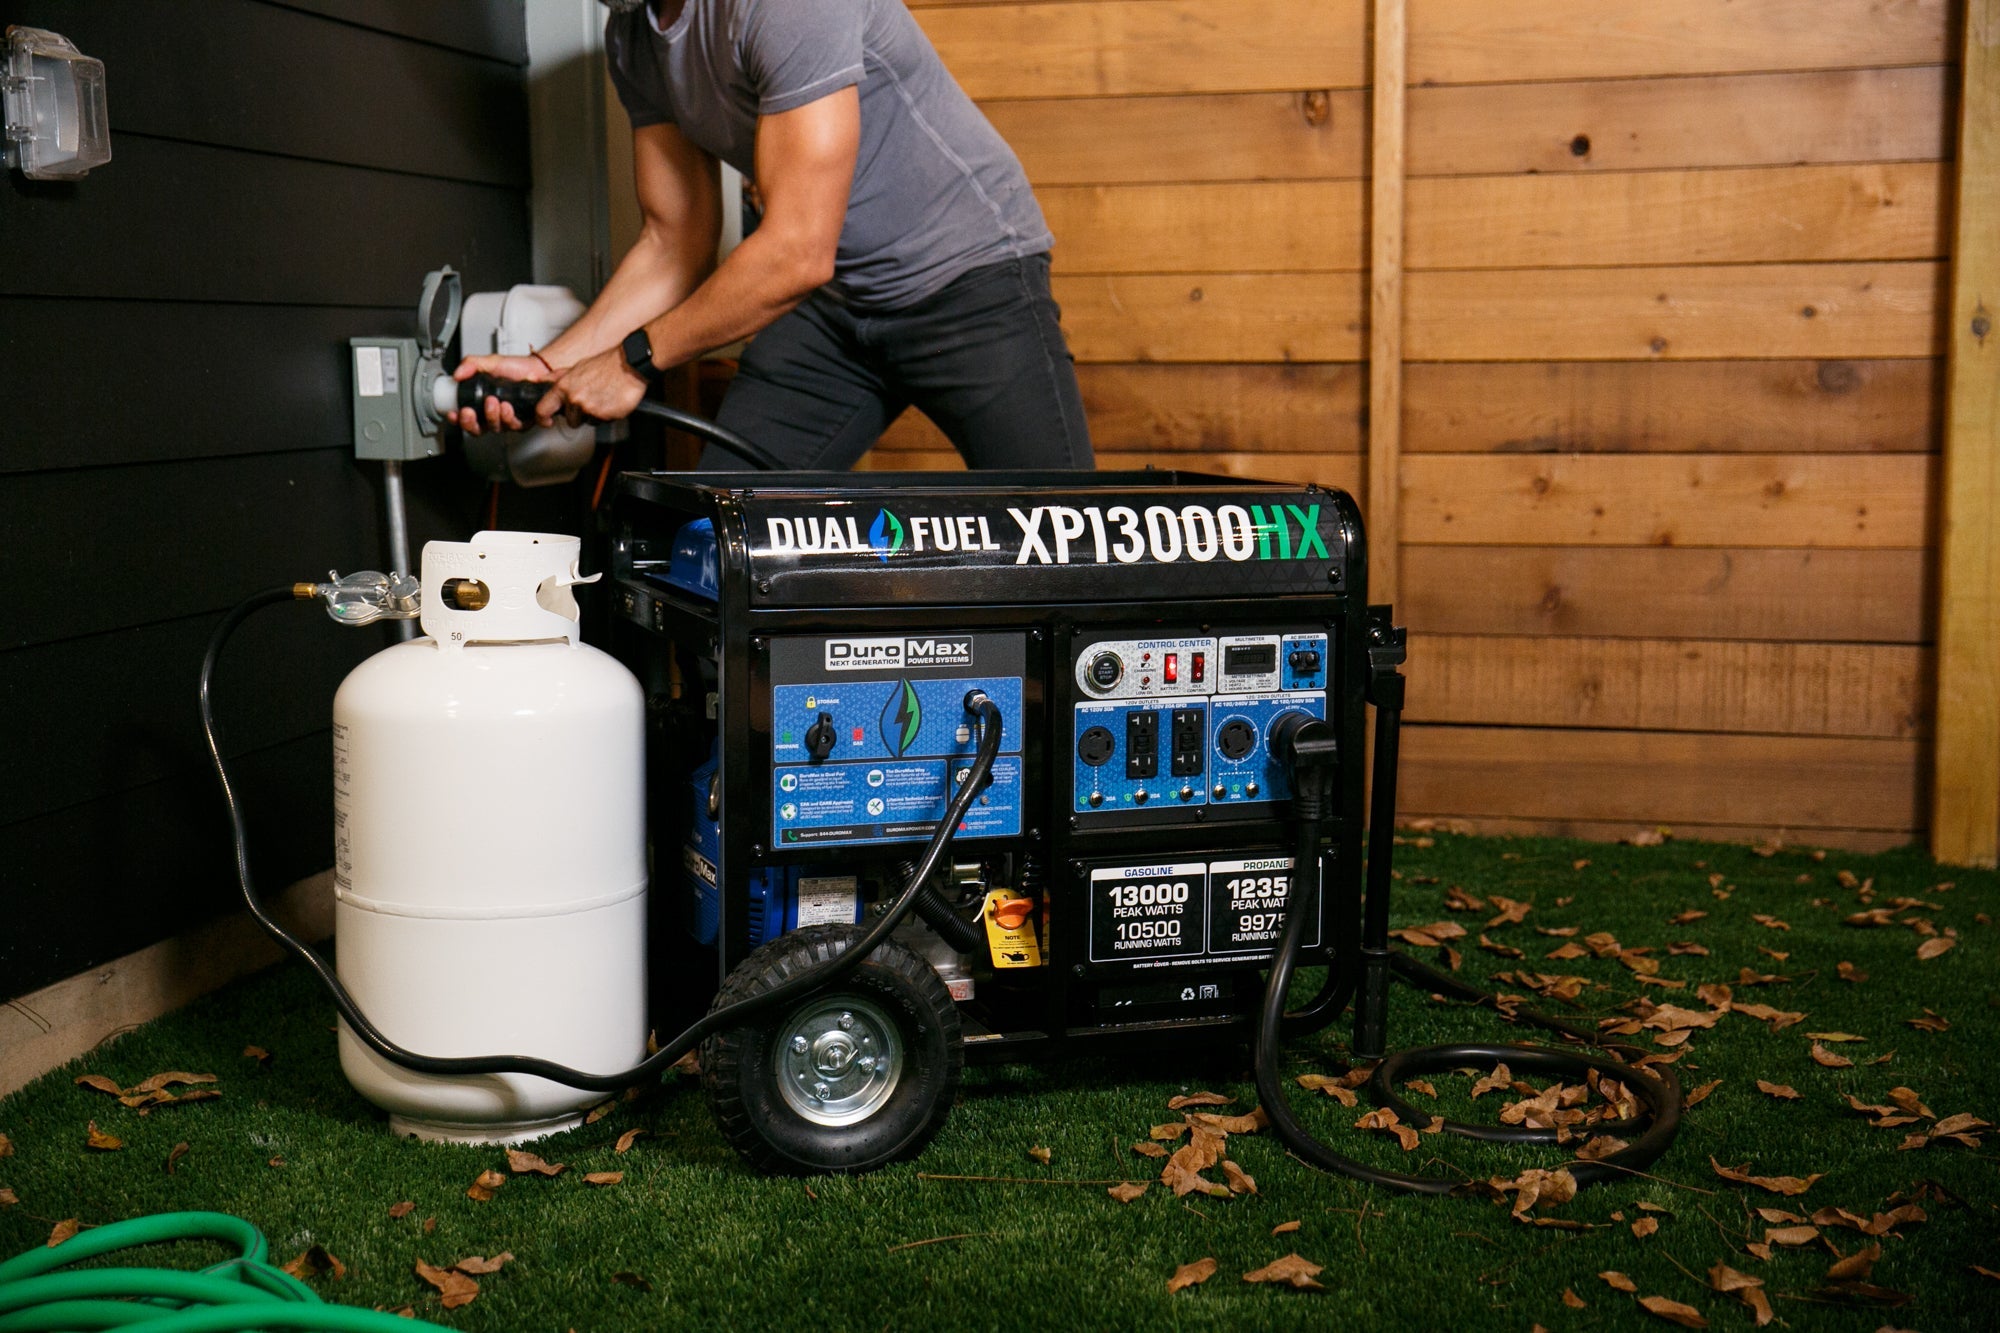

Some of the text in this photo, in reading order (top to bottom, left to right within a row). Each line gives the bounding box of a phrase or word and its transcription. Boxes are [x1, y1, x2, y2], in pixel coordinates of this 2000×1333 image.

[767, 504, 1329, 564] DUAL FUEL XP13000HX
[451, 632, 462, 641] 50
[1137, 639, 1211, 649] CONTROL CENTER
[852, 658, 900, 666] GENERATION
[907, 657, 934, 665] POWER
[935, 656, 969, 664] SYSTEMS
[700, 860, 716, 885] Max
[1124, 866, 1174, 877] GASOLINE
[1243, 860, 1289, 870] PROPANE
[1108, 882, 1189, 908] 13000
[1226, 876, 1294, 900] 1235
[1113, 903, 1184, 919] PEAK WATTS
[1231, 896, 1290, 911] PEAK WAT
[1116, 919, 1181, 941] 10500
[1231, 932, 1269, 943] RUNNING
[1114, 936, 1182, 951] RUNNING WATTS
